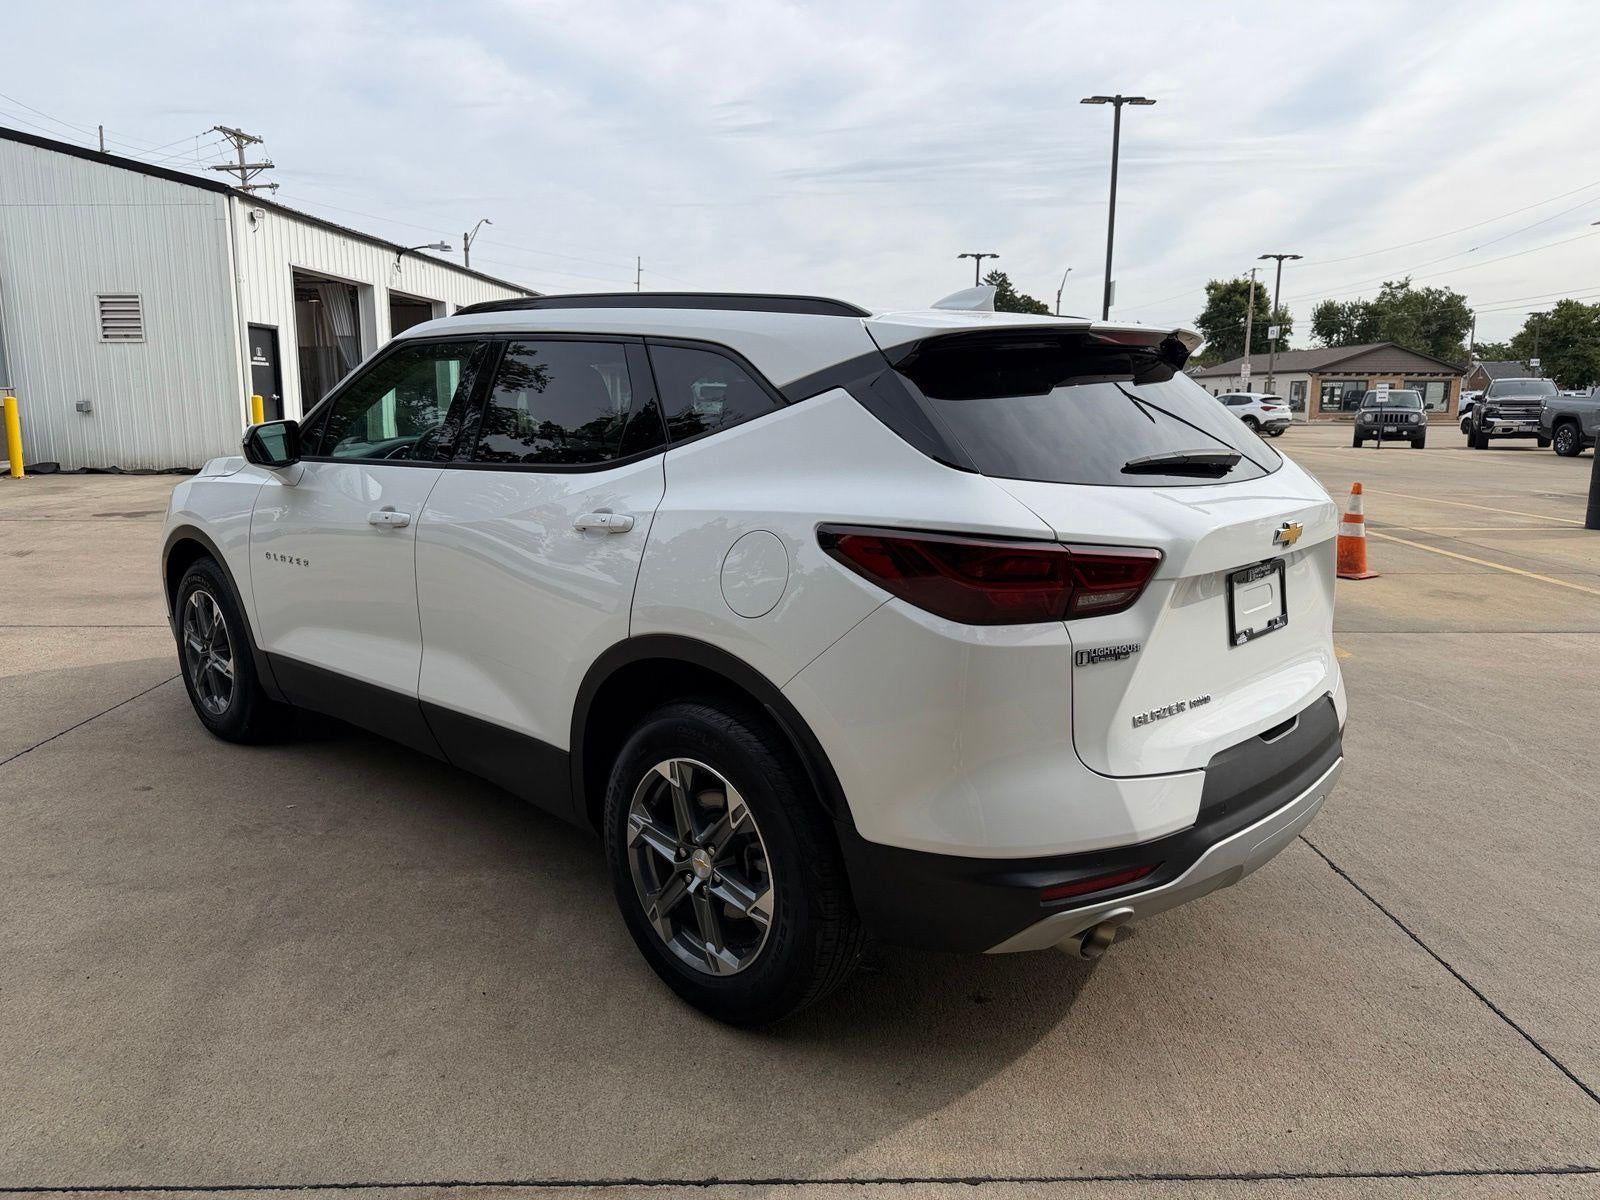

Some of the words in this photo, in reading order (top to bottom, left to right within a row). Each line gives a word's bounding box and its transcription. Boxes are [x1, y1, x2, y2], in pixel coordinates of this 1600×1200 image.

[265, 551, 309, 568] BLAZER
[1090, 643, 1141, 657] LIGHTHOUSE
[1132, 699, 1187, 729] BLAZER
